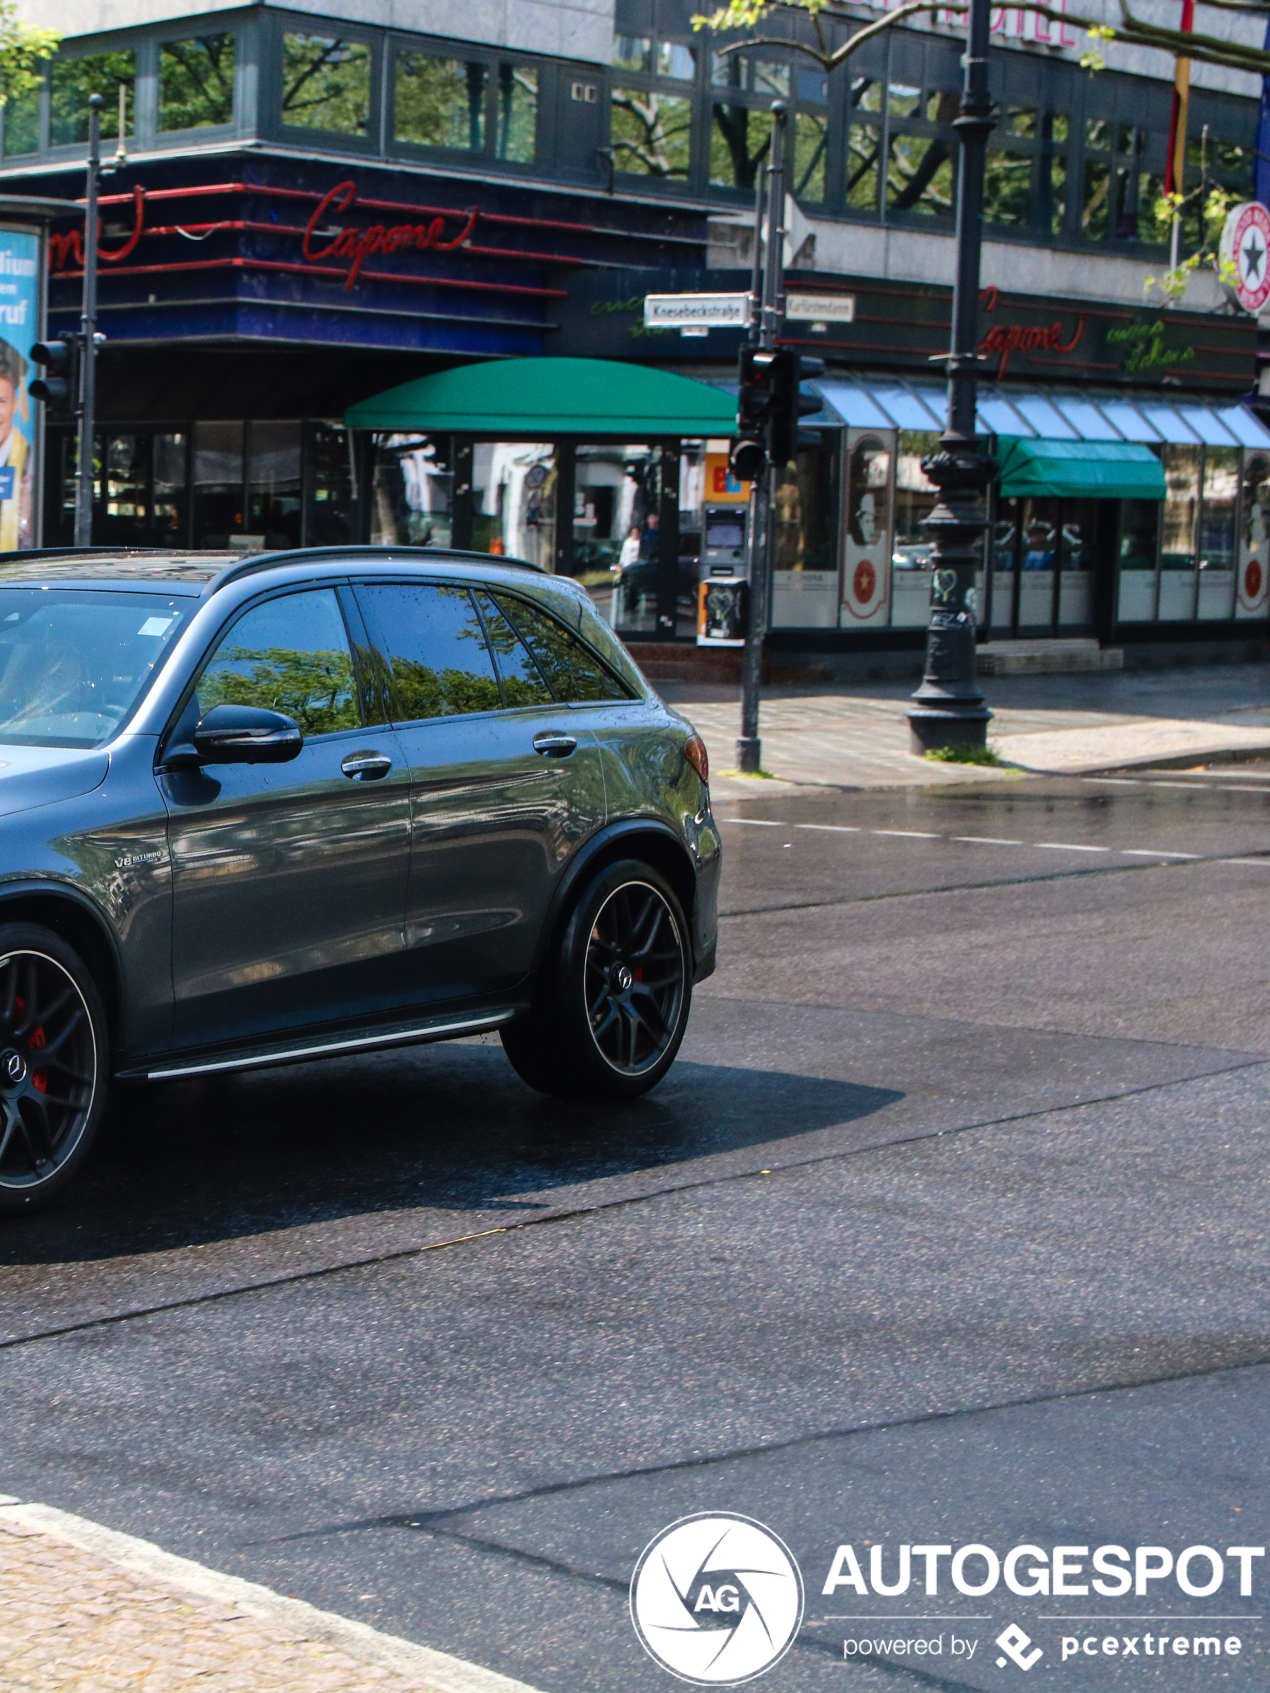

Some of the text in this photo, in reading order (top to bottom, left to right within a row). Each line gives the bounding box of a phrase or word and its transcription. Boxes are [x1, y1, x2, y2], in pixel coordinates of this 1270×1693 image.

[303, 180, 479, 291] Capone
[653, 303, 740, 320] Knesebeckstraße
[114, 856, 132, 868] V8
